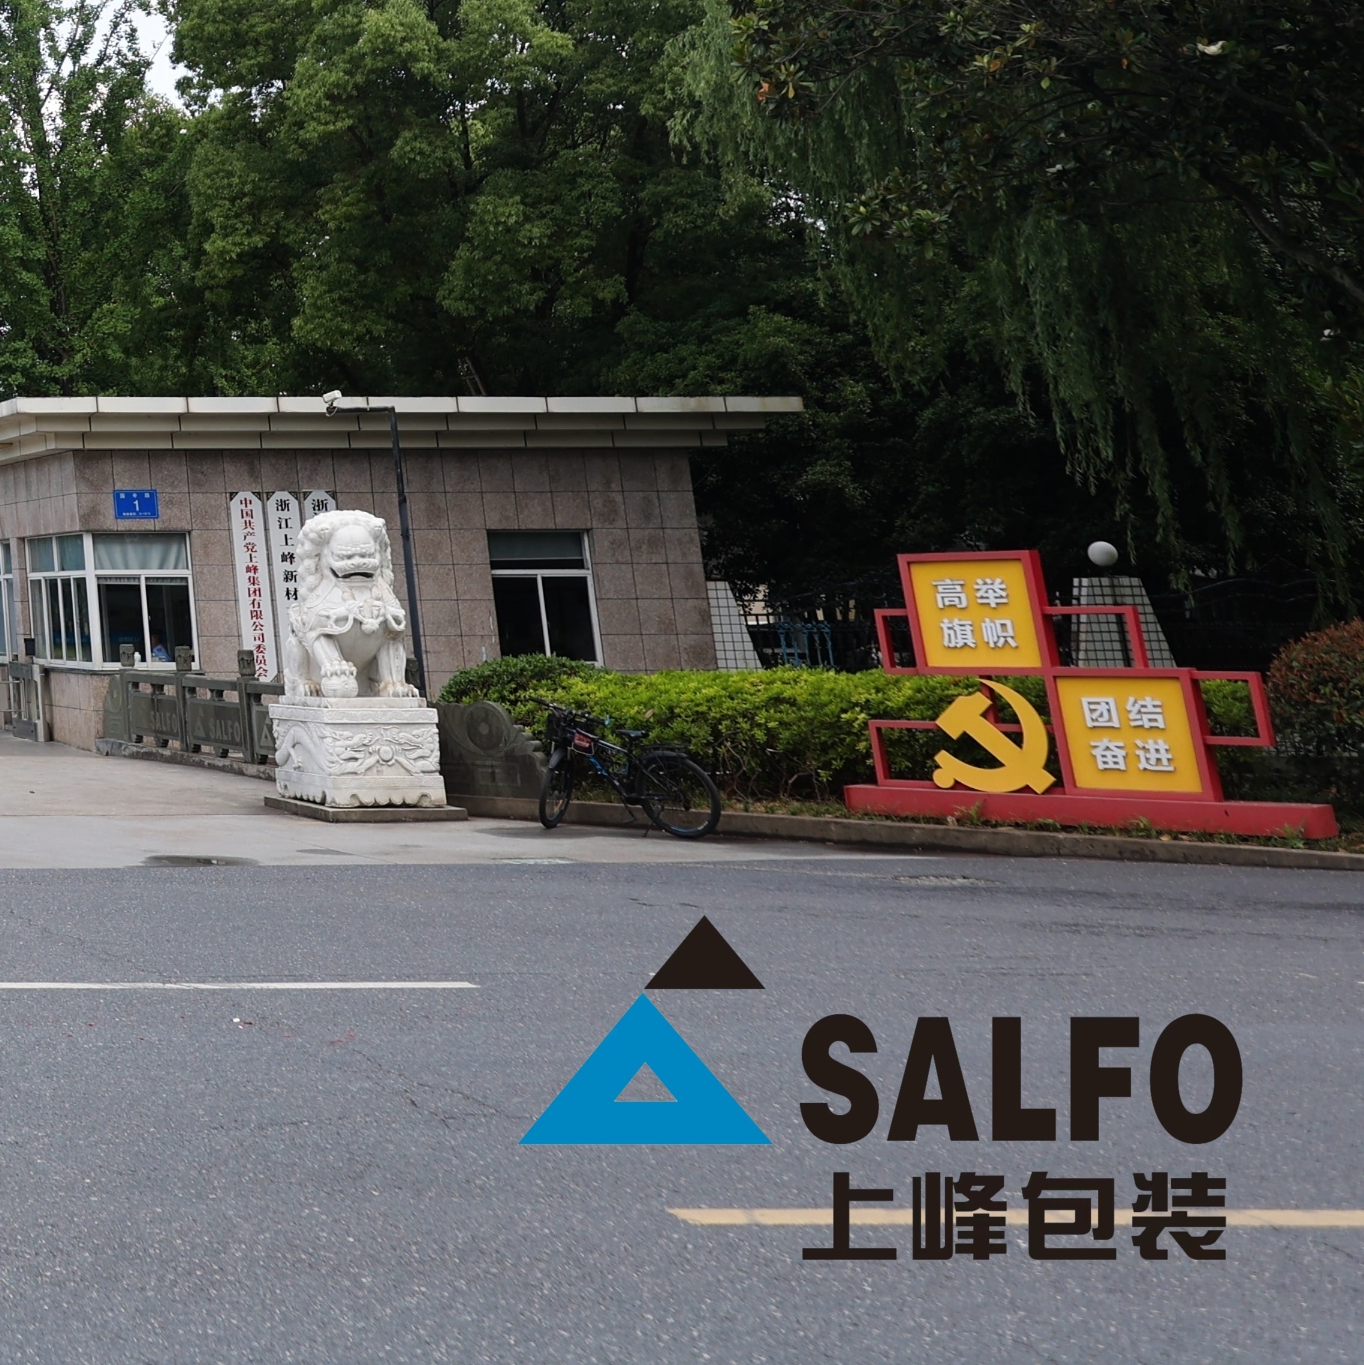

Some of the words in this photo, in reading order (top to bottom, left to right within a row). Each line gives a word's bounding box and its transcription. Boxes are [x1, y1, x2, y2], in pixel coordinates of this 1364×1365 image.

[133, 499, 139, 512] 1
[312, 498, 329, 515] 浙
[275, 498, 300, 616] 浙江上峰新材
[239, 497, 269, 678] 中国共产党上峰集团有限公司委员会
[931, 578, 1010, 609] 高举
[939, 617, 1019, 649] 旗帜
[150, 711, 179, 734] SALFO
[1080, 696, 1167, 729] 团结
[208, 718, 241, 743] SALFO
[1089, 737, 1175, 772] 奋进
